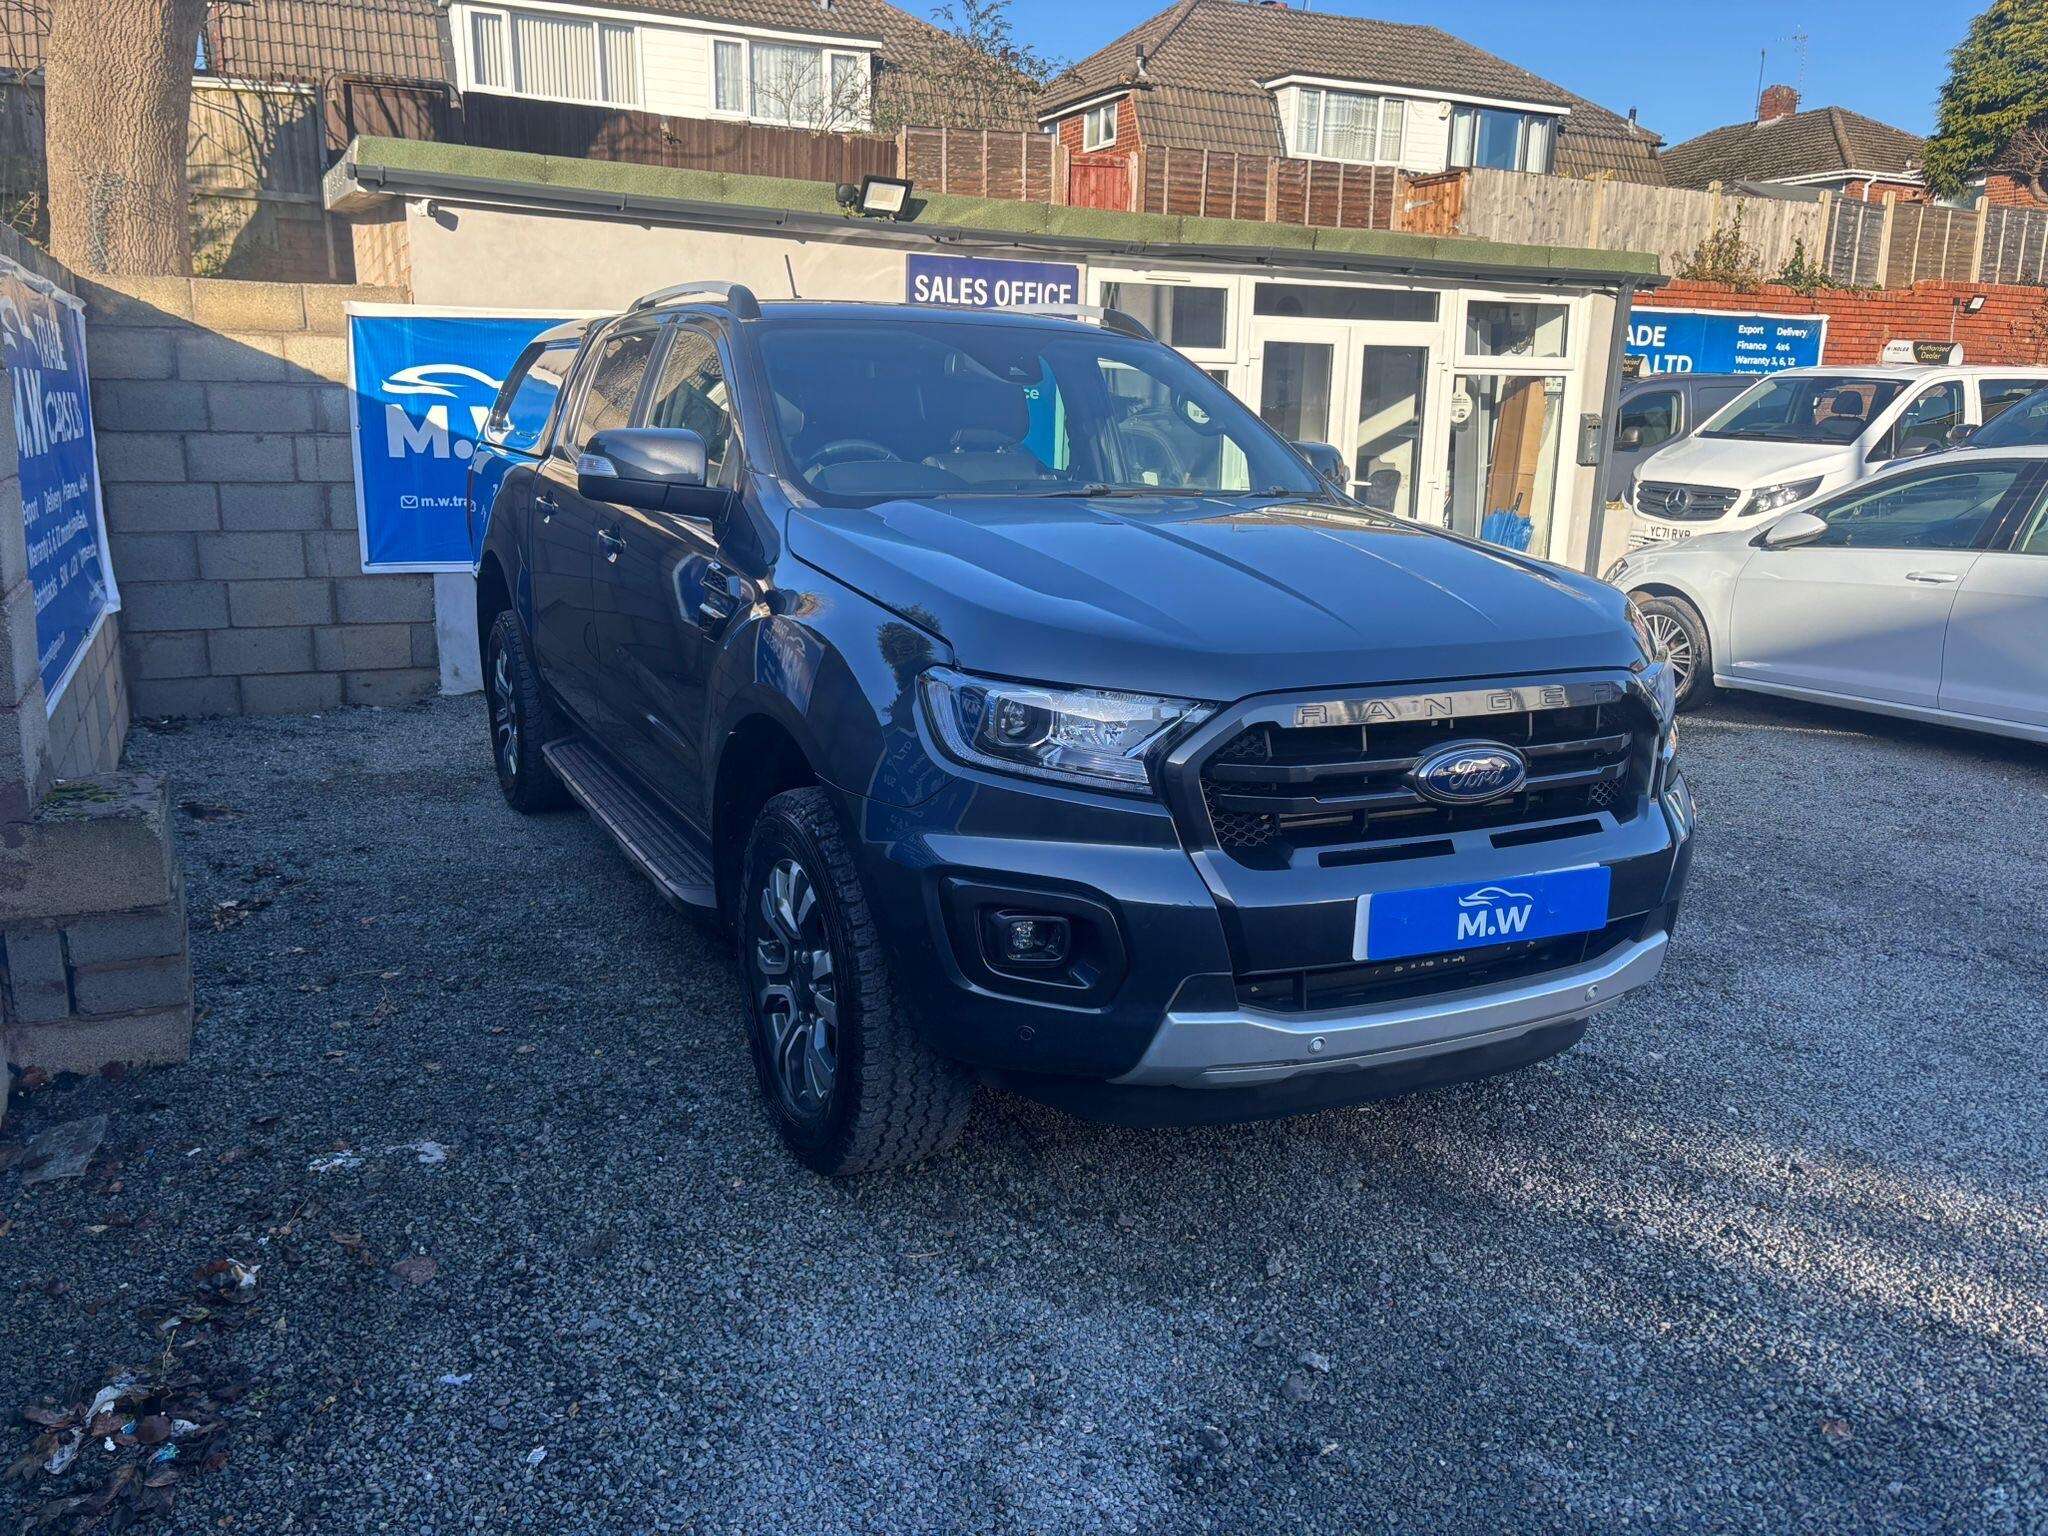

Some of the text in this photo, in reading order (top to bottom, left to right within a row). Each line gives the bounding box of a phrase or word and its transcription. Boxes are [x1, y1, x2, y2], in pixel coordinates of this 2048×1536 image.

[914, 274, 1072, 306] SALES OFFICE
[1738, 324, 1808, 338] Export Delivery
[1736, 340, 1790, 351] Finance 4x4
[1653, 354, 1693, 373] LTD
[1735, 355, 1771, 367] Warranty
[1787, 357, 1796, 366] 12
[1920, 351, 1941, 360] Dealer
[1650, 525, 1670, 538] YC71
[1296, 683, 1613, 725] RANGER
[1448, 757, 1511, 789] Ford
[1457, 904, 1533, 941] M.W
